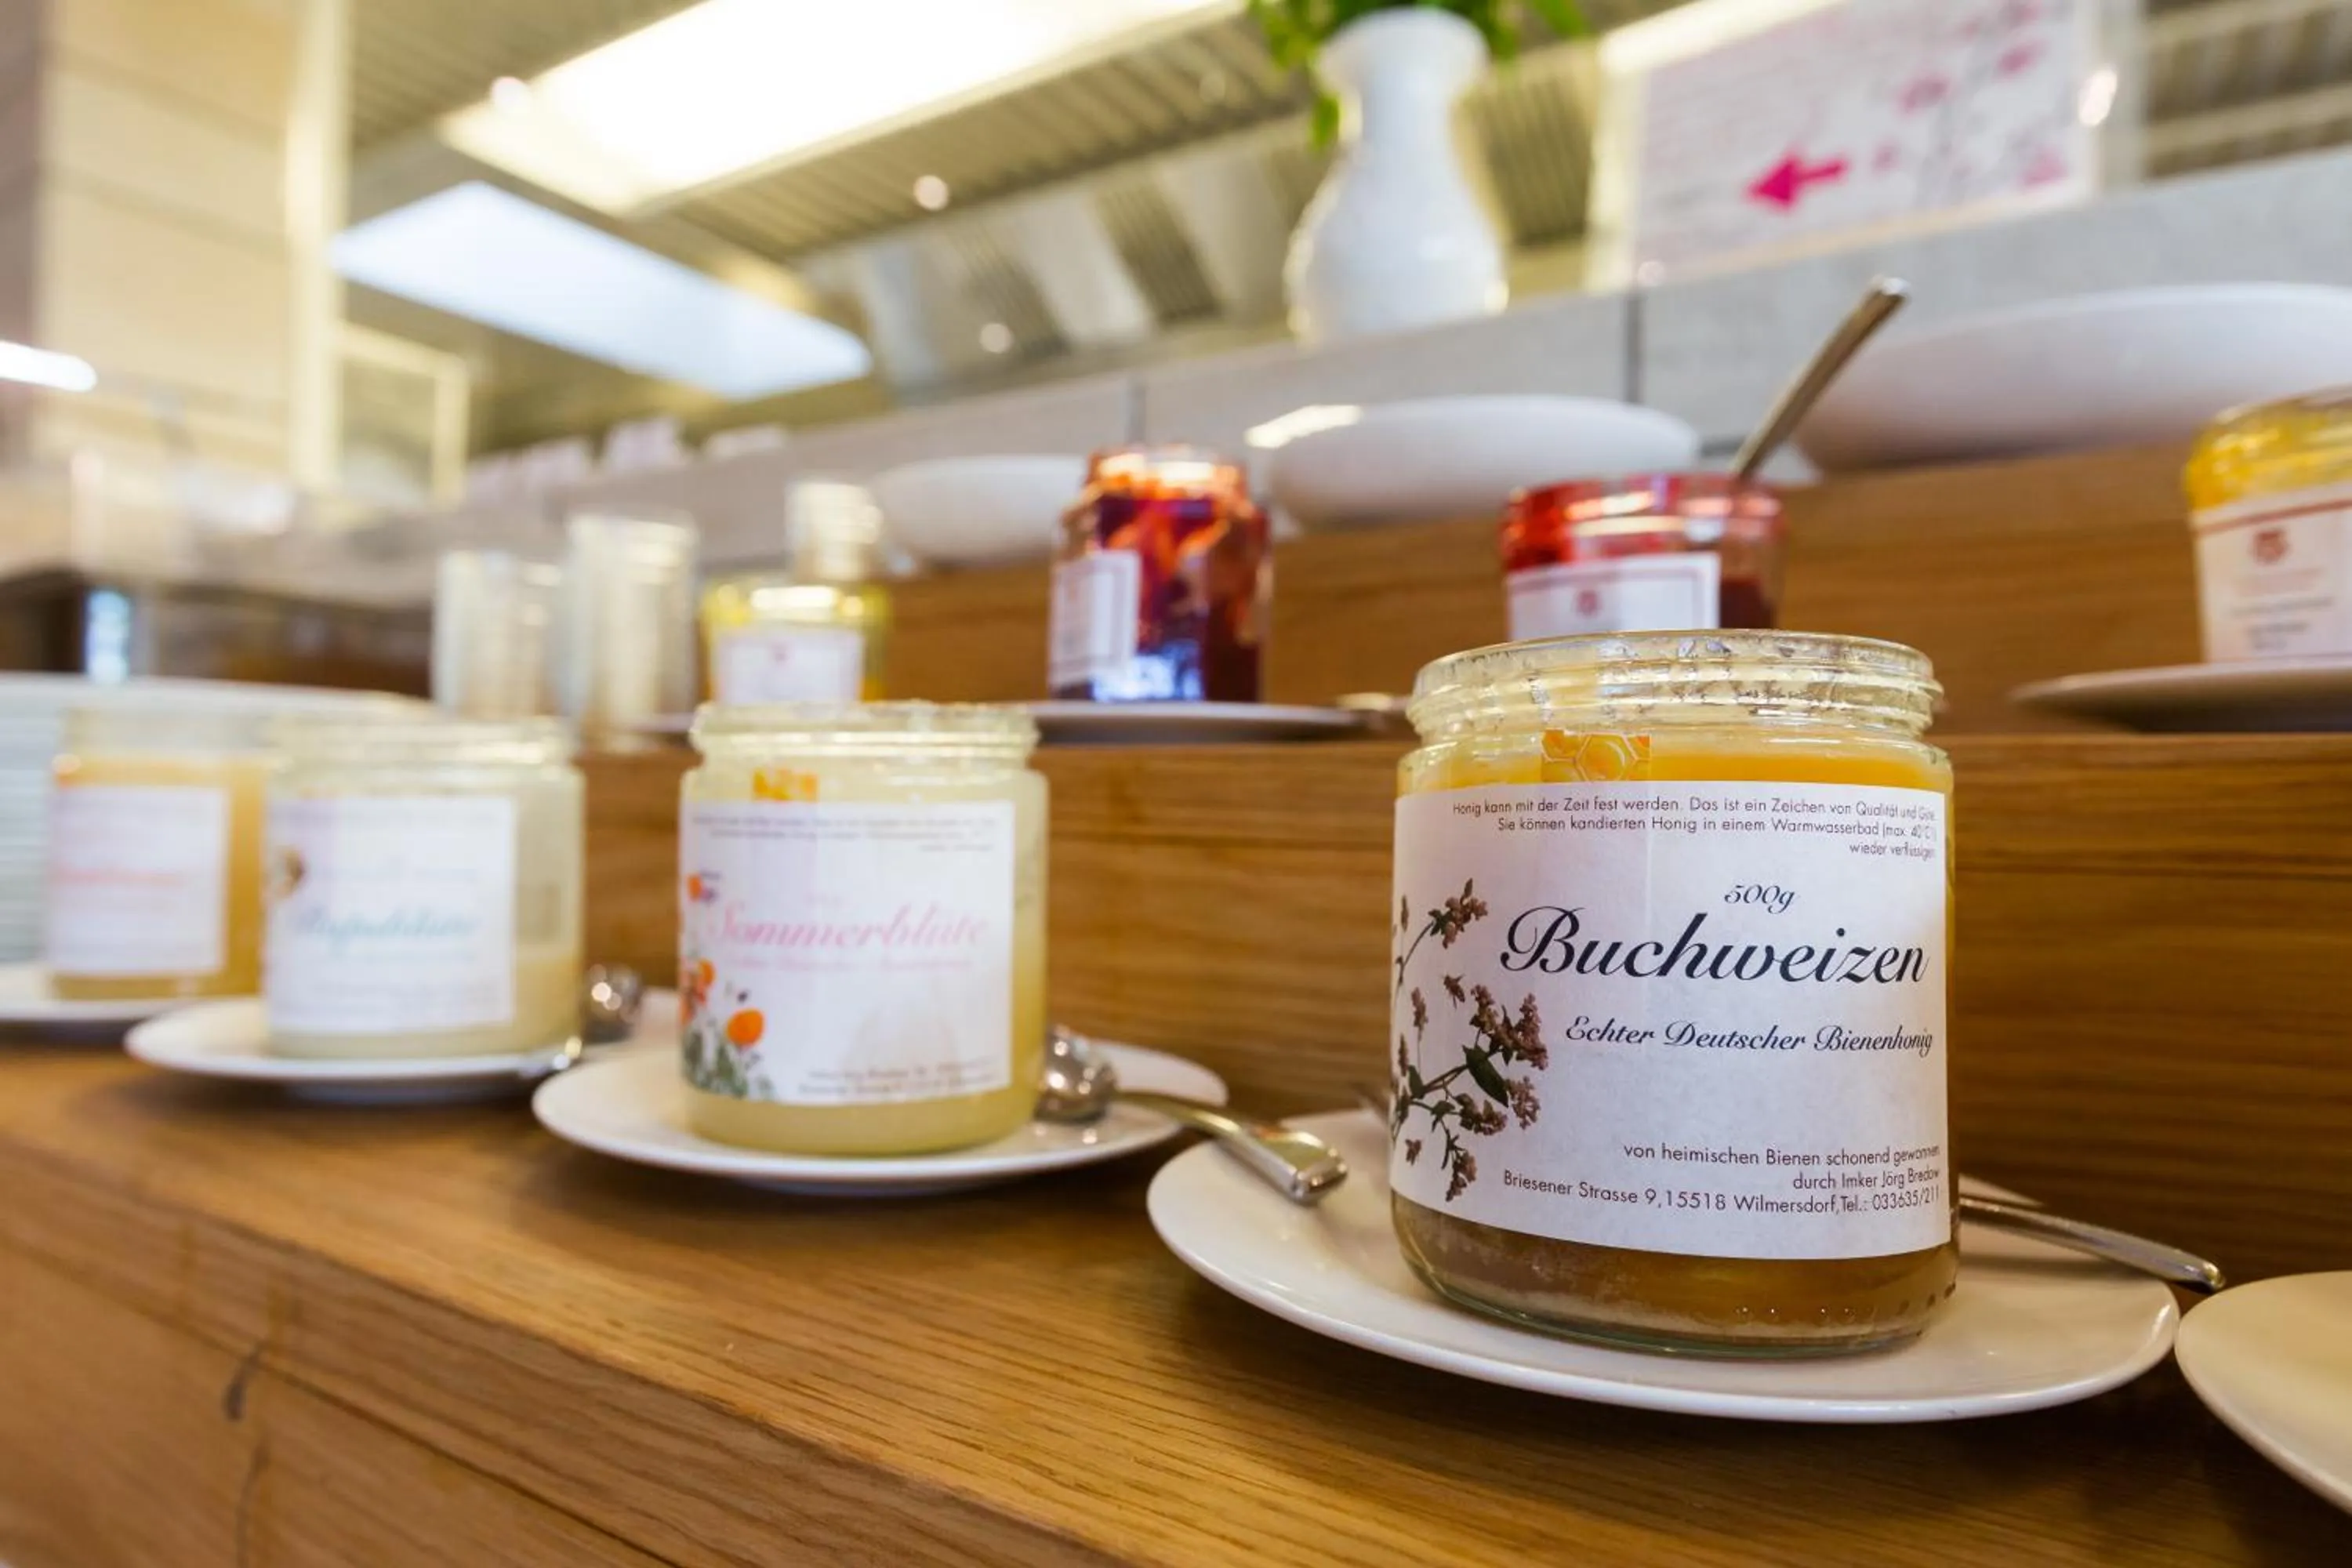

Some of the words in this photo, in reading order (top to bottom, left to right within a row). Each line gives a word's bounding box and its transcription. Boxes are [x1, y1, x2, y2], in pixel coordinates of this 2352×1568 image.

[1453, 802, 1481, 817] Honig
[1484, 799, 1512, 814] kann
[1515, 798, 1534, 812] mit
[1537, 797, 1559, 812] der
[1563, 797, 1589, 812] Zeit
[1594, 795, 1618, 811] fest
[1690, 796, 1718, 812] Das
[1724, 797, 1739, 812] ist
[1744, 797, 1766, 812] ein
[1771, 797, 1826, 815] Zeichen
[1830, 803, 1851, 815] von
[1498, 817, 1515, 831] Sie
[1519, 815, 1565, 830] können
[1570, 815, 1646, 831] kandierten
[1652, 816, 1697, 833] Honig
[1703, 816, 1716, 831] in
[1722, 817, 1766, 832] einem
[1771, 818, 1878, 836] Warmwasserbad
[1849, 841, 1886, 856] wieder
[1724, 884, 1797, 914] 500g
[1500, 906, 1930, 984] Buchweizen
[1566, 1016, 1654, 1045] Echter
[1664, 1019, 1806, 1051] Deutscher
[1813, 1024, 1933, 1058] Bienenhonig
[1624, 1145, 1655, 1159] von
[1661, 1142, 1759, 1165] heimischen
[1766, 1148, 1820, 1166] Bienen
[1826, 1146, 1890, 1166] schonend
[1893, 1145, 1940, 1167] gewonnen
[1504, 1169, 1573, 1196] Briesener
[1578, 1181, 1638, 1203] Strasse
[1793, 1172, 1836, 1189] durch
[1842, 1172, 1878, 1189] Imker
[1881, 1171, 1904, 1189] Jörg
[1907, 1167, 1940, 1184] Bredow
